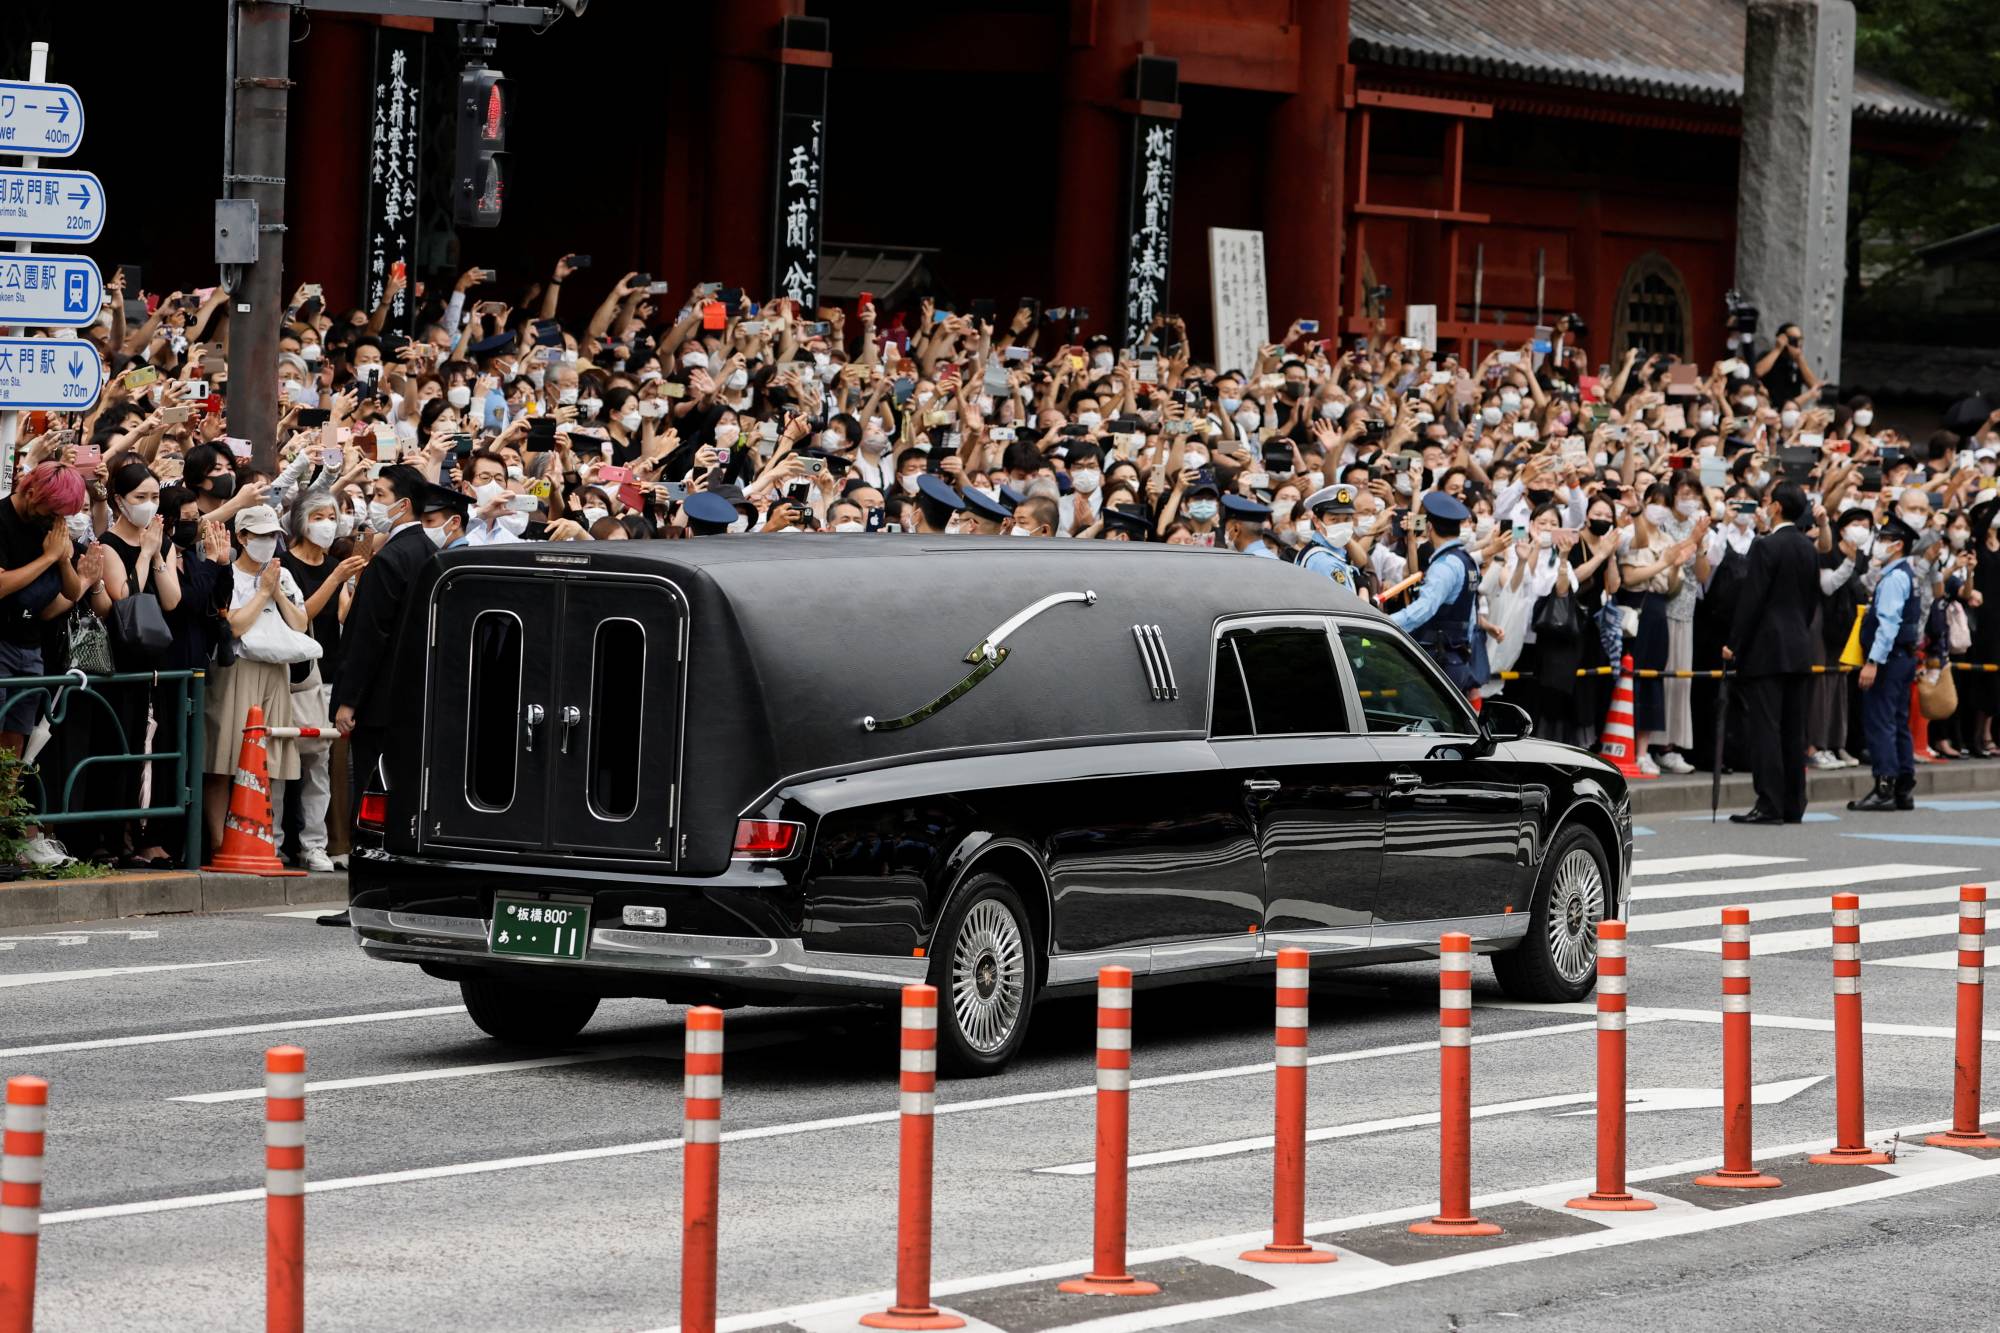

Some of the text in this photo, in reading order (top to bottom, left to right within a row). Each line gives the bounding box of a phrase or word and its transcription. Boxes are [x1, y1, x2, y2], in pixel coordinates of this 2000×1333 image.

[45, 129, 70, 144] 400m
[67, 215, 91, 230] 220m
[0, 263, 57, 290] 公園駅
[0, 347, 56, 375] 大門駅
[63, 383, 88, 398] 370m
[517, 906, 567, 924] 板橋 800
[498, 930, 510, 944] あ
